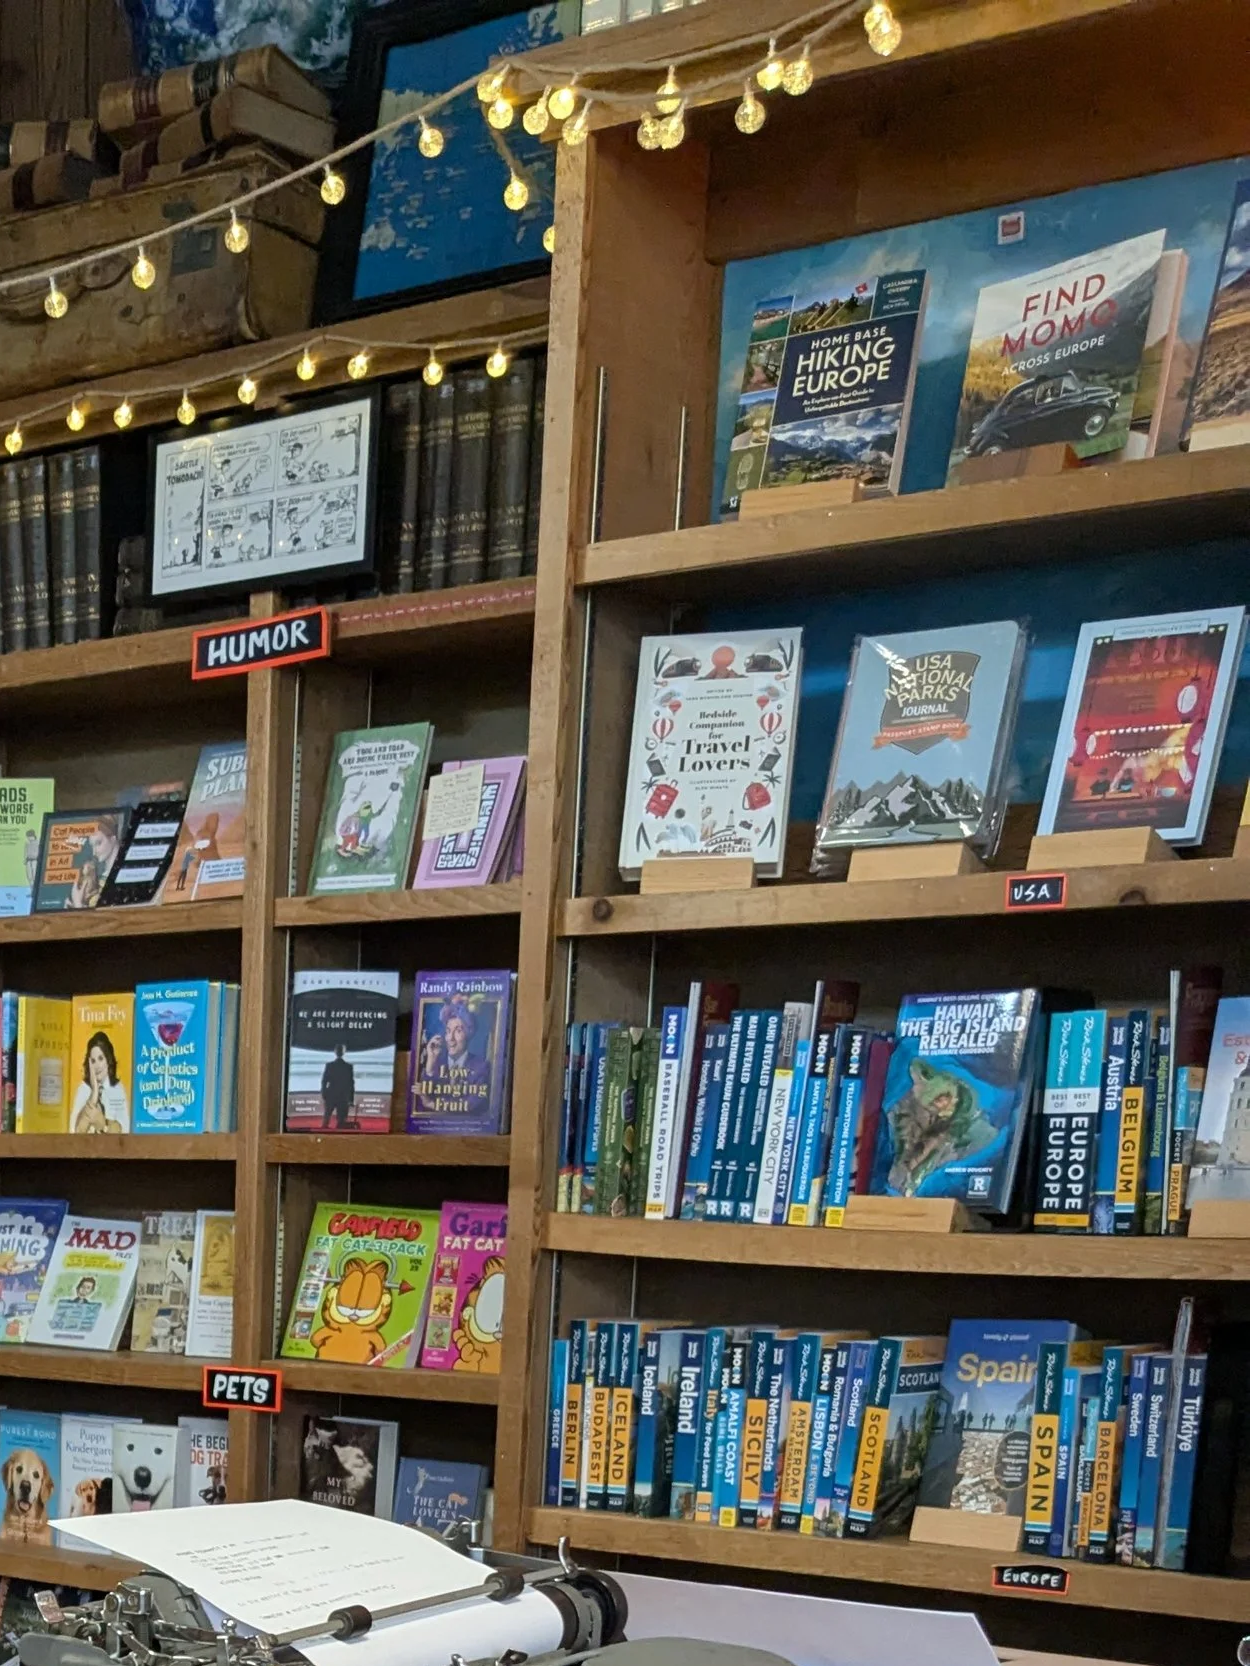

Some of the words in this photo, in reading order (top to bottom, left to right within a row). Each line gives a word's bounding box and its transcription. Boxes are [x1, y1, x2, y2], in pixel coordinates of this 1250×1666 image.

[1022, 274, 1105, 322] FIND
[811, 334, 850, 349] HOME
[855, 326, 887, 341] BASE
[1000, 298, 1118, 357] MOMO
[796, 337, 895, 374] HIKING
[1001, 353, 1050, 376] ACROSS
[1054, 335, 1105, 360] EUROPE
[793, 359, 892, 397] EUROPE
[205, 618, 309, 667] HUMOR
[916, 654, 952, 672] USA
[897, 684, 960, 708] PARKS
[901, 703, 948, 717] JOURNAL
[690, 721, 744, 730] Companion
[699, 710, 737, 719] Bedside
[682, 735, 750, 754] Travel
[708, 732, 724, 740] for
[679, 757, 750, 772] Lovers
[1, 804, 35, 814] WORSE
[10, 815, 27, 824] YOU
[53, 827, 68, 836] Cat
[69, 826, 95, 835] People
[1013, 881, 1051, 901] USA
[420, 981, 452, 996] Randy
[456, 981, 503, 994] Rainbow
[78, 1006, 105, 1023] Tina
[108, 1004, 126, 1026] Fey
[312, 1010, 327, 1018] ARE
[331, 1011, 388, 1019] EXPERIENCING
[316, 1021, 344, 1029] SLIGHT
[747, 1015, 759, 1039] MAUI
[765, 1015, 778, 1042] OAHU
[901, 1021, 930, 1037] THE
[933, 1020, 961, 1035] BIG
[965, 1016, 1026, 1033] ISLAND
[934, 1003, 995, 1021] HAWAII
[664, 1014, 678, 1055] MOON
[919, 1032, 999, 1050] REVEALED
[137, 1064, 149, 1075] of
[151, 1060, 198, 1075] Genetics
[439, 1064, 475, 1079] Low-
[740, 1040, 755, 1084] REVEALED
[759, 1042, 774, 1086] REVEALED
[814, 1034, 830, 1074] MOON
[849, 1035, 862, 1074] MOON
[421, 1081, 488, 1097] Hanging
[659, 1063, 673, 1124] BASEBALL
[1105, 1054, 1125, 1111] Austria
[434, 1098, 469, 1112] Fruit
[774, 1088, 786, 1117] NEW
[655, 1126, 667, 1161] ROAD
[769, 1118, 781, 1155] YORK
[1118, 1097, 1139, 1194] BELGIUM
[764, 1156, 776, 1185] CITY
[1042, 1117, 1066, 1209] EUROPE
[1064, 1116, 1089, 1210] EUROPE
[652, 1164, 663, 1199] TRIPS
[778, 1170, 788, 1199] CITY
[1169, 1170, 1180, 1215] PRAGUE
[20, 1224, 33, 1235] BE
[64, 1227, 137, 1251] MAD
[315, 1236, 339, 1247] FAT
[342, 1238, 369, 1250] CAT
[328, 1212, 422, 1241] GARFIELD
[443, 1238, 471, 1250] FAT
[474, 1238, 504, 1252] CAT
[732, 1347, 742, 1385] MOON
[820, 1353, 832, 1391] MOON
[899, 1372, 940, 1387] SCOTLAN
[212, 1374, 270, 1404] PETS
[641, 1365, 657, 1416] Iceland
[678, 1366, 701, 1434] Ireland
[769, 1375, 782, 1396] The
[829, 1376, 845, 1422] Romania
[847, 1378, 863, 1428] Scotland
[704, 1389, 719, 1420] Italy
[727, 1390, 740, 1439] AMALFI
[1129, 1393, 1143, 1437] Sweden
[79, 1428, 107, 1444] Puppy
[551, 1409, 560, 1449] GREECE
[565, 1400, 578, 1465] BERLIN
[590, 1392, 605, 1483] BUDAPEST
[612, 1394, 628, 1480] ICELAND
[763, 1398, 778, 1472] Netherlands
[812, 1399, 827, 1451] LISBON
[1146, 1395, 1163, 1458] Switzerland
[1179, 1396, 1201, 1452] Türkiye
[724, 1441, 736, 1486] COAST
[744, 1415, 763, 1486] SICILY
[790, 1408, 807, 1498] AMSTERDAM
[822, 1433, 838, 1478] Bulgaria
[856, 1413, 881, 1507] SCOTLAND
[1057, 1445, 1069, 1480] SPAIN
[326, 1477, 342, 1488] MY
[1030, 1426, 1054, 1512] SPAIN
[1092, 1428, 1111, 1527] BARCELONA
[312, 1491, 355, 1507] BELOVED
[413, 1495, 433, 1506] THE
[1002, 1569, 1061, 1588] EUROPE
